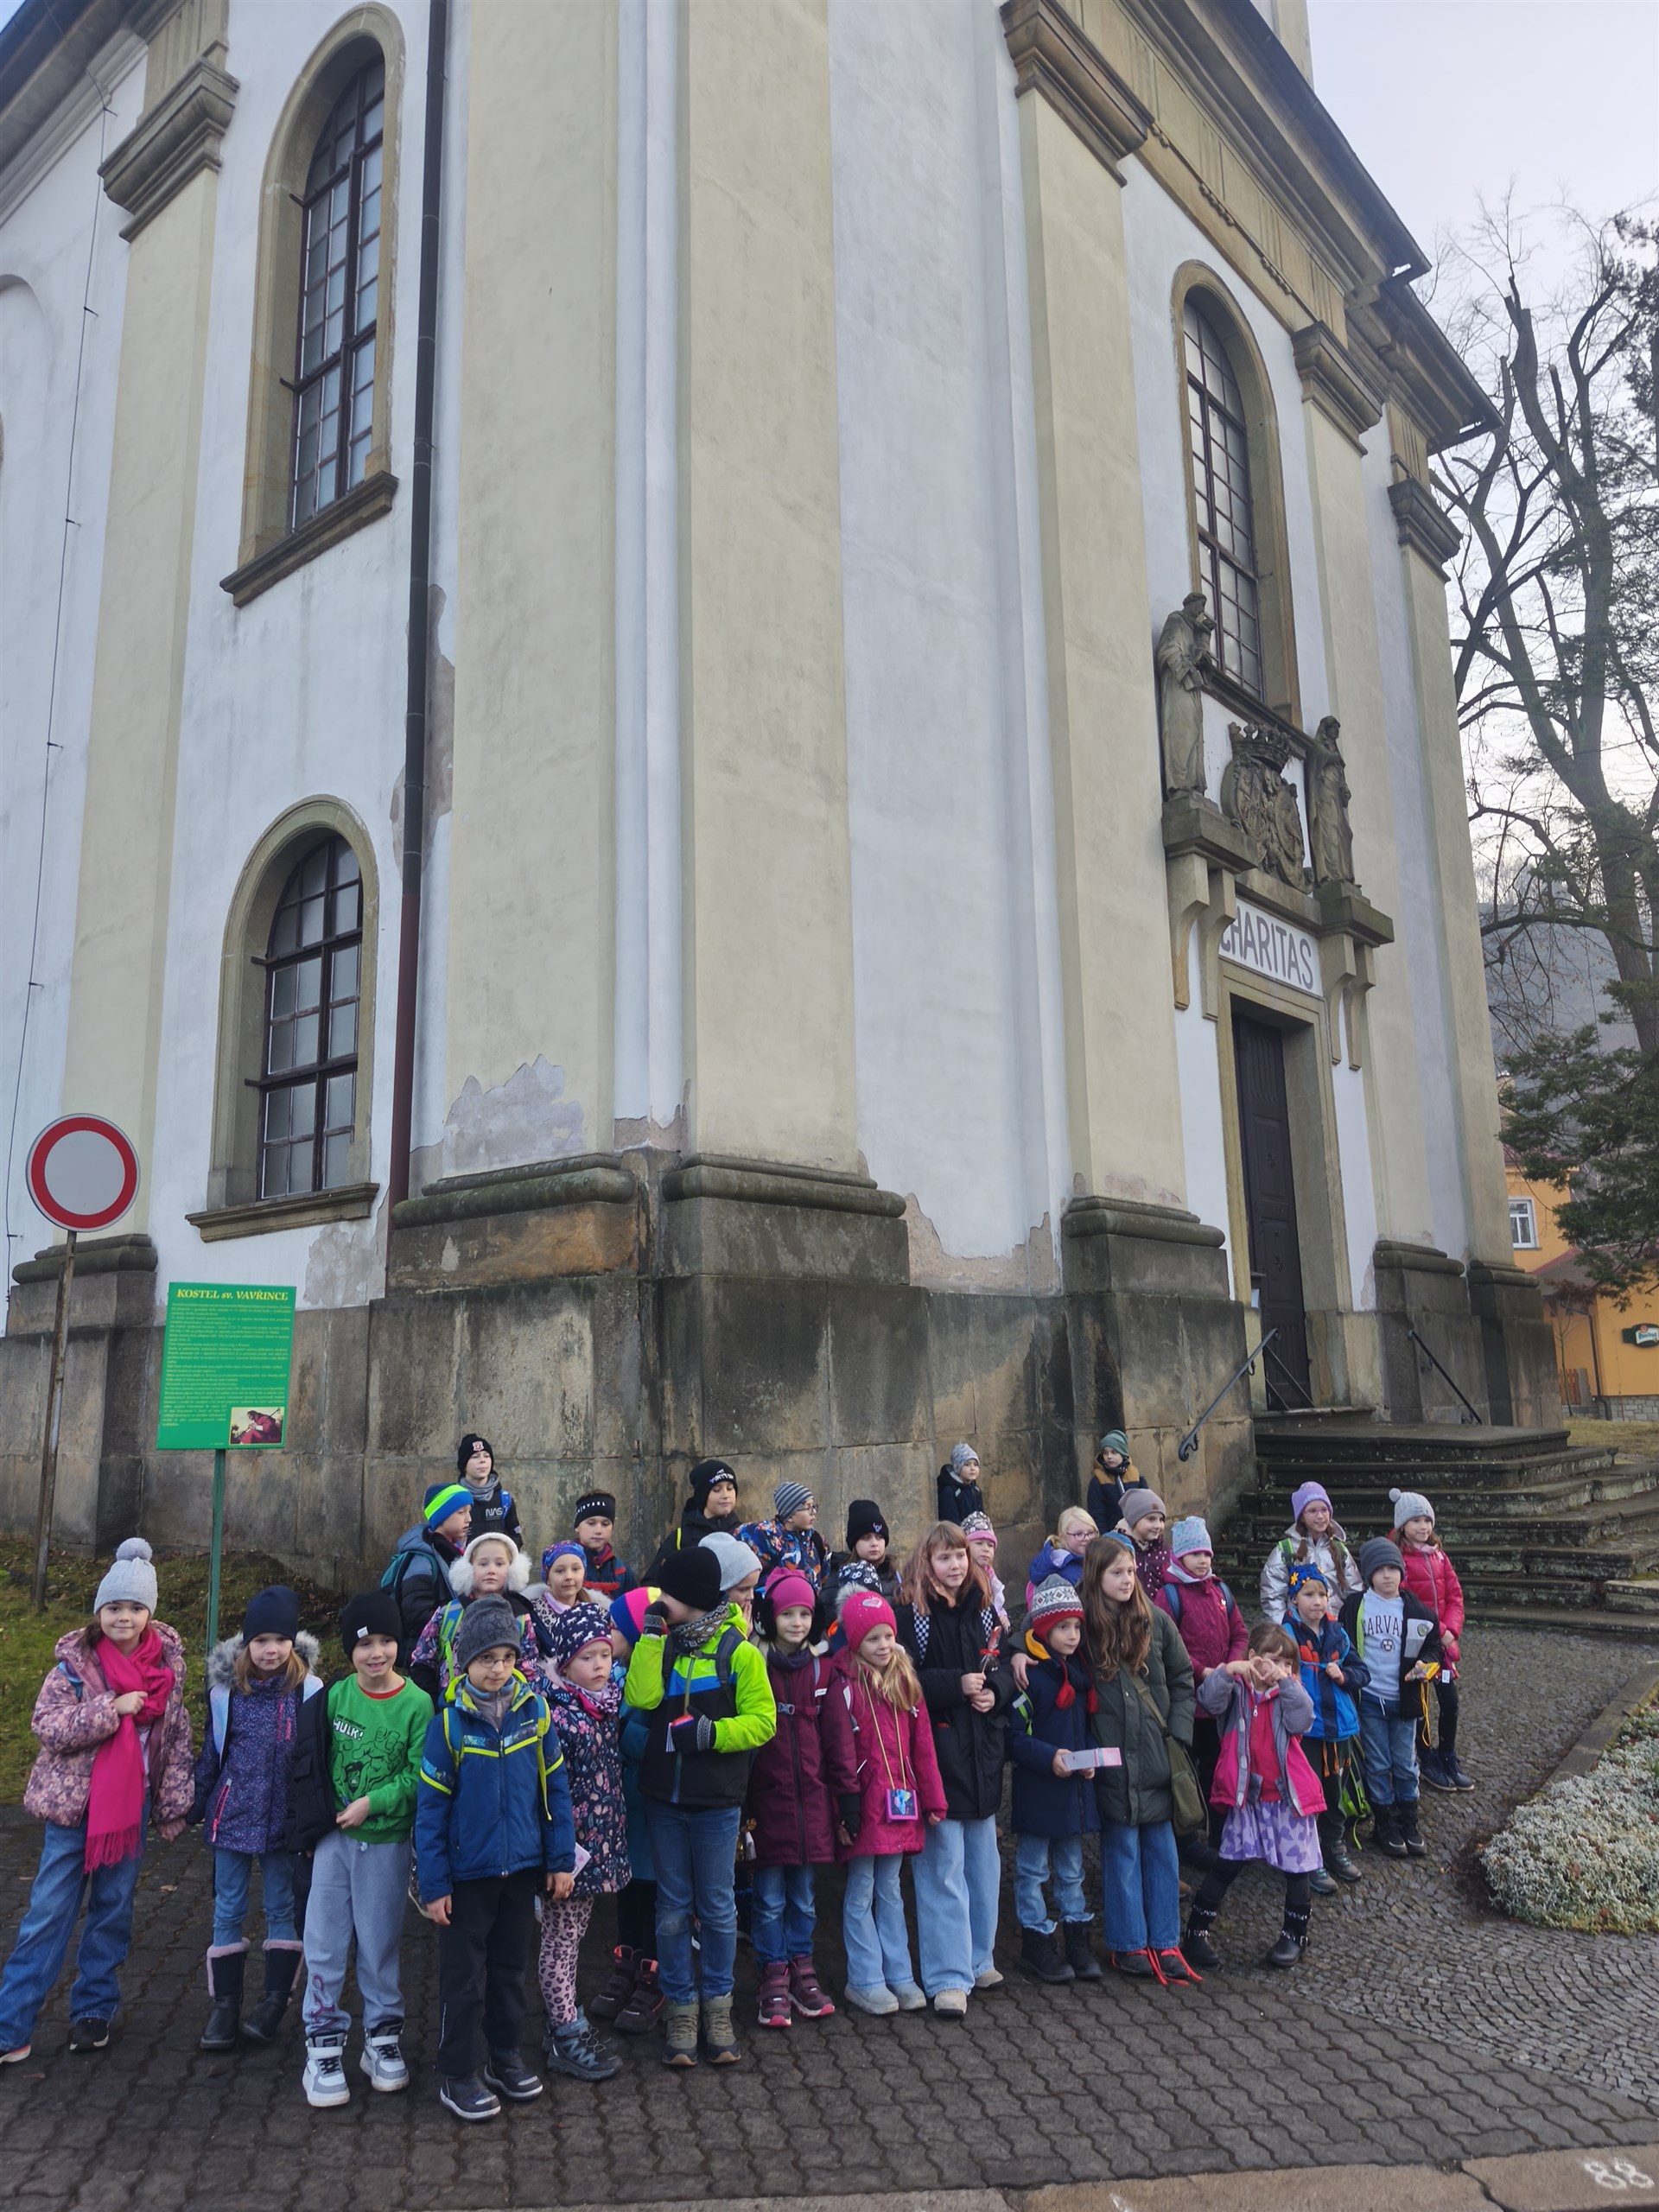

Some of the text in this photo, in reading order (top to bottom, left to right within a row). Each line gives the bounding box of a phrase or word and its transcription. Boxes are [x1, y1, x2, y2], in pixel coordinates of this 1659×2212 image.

[177, 1288, 219, 1299] KOSTEL
[236, 1289, 289, 1300] VAVŘINCE
[485, 1508, 503, 1517] NAS
[1363, 1615, 1403, 1637] ARVA
[333, 1719, 364, 1740] HULK!
[1584, 2158, 1655, 2190] 88
